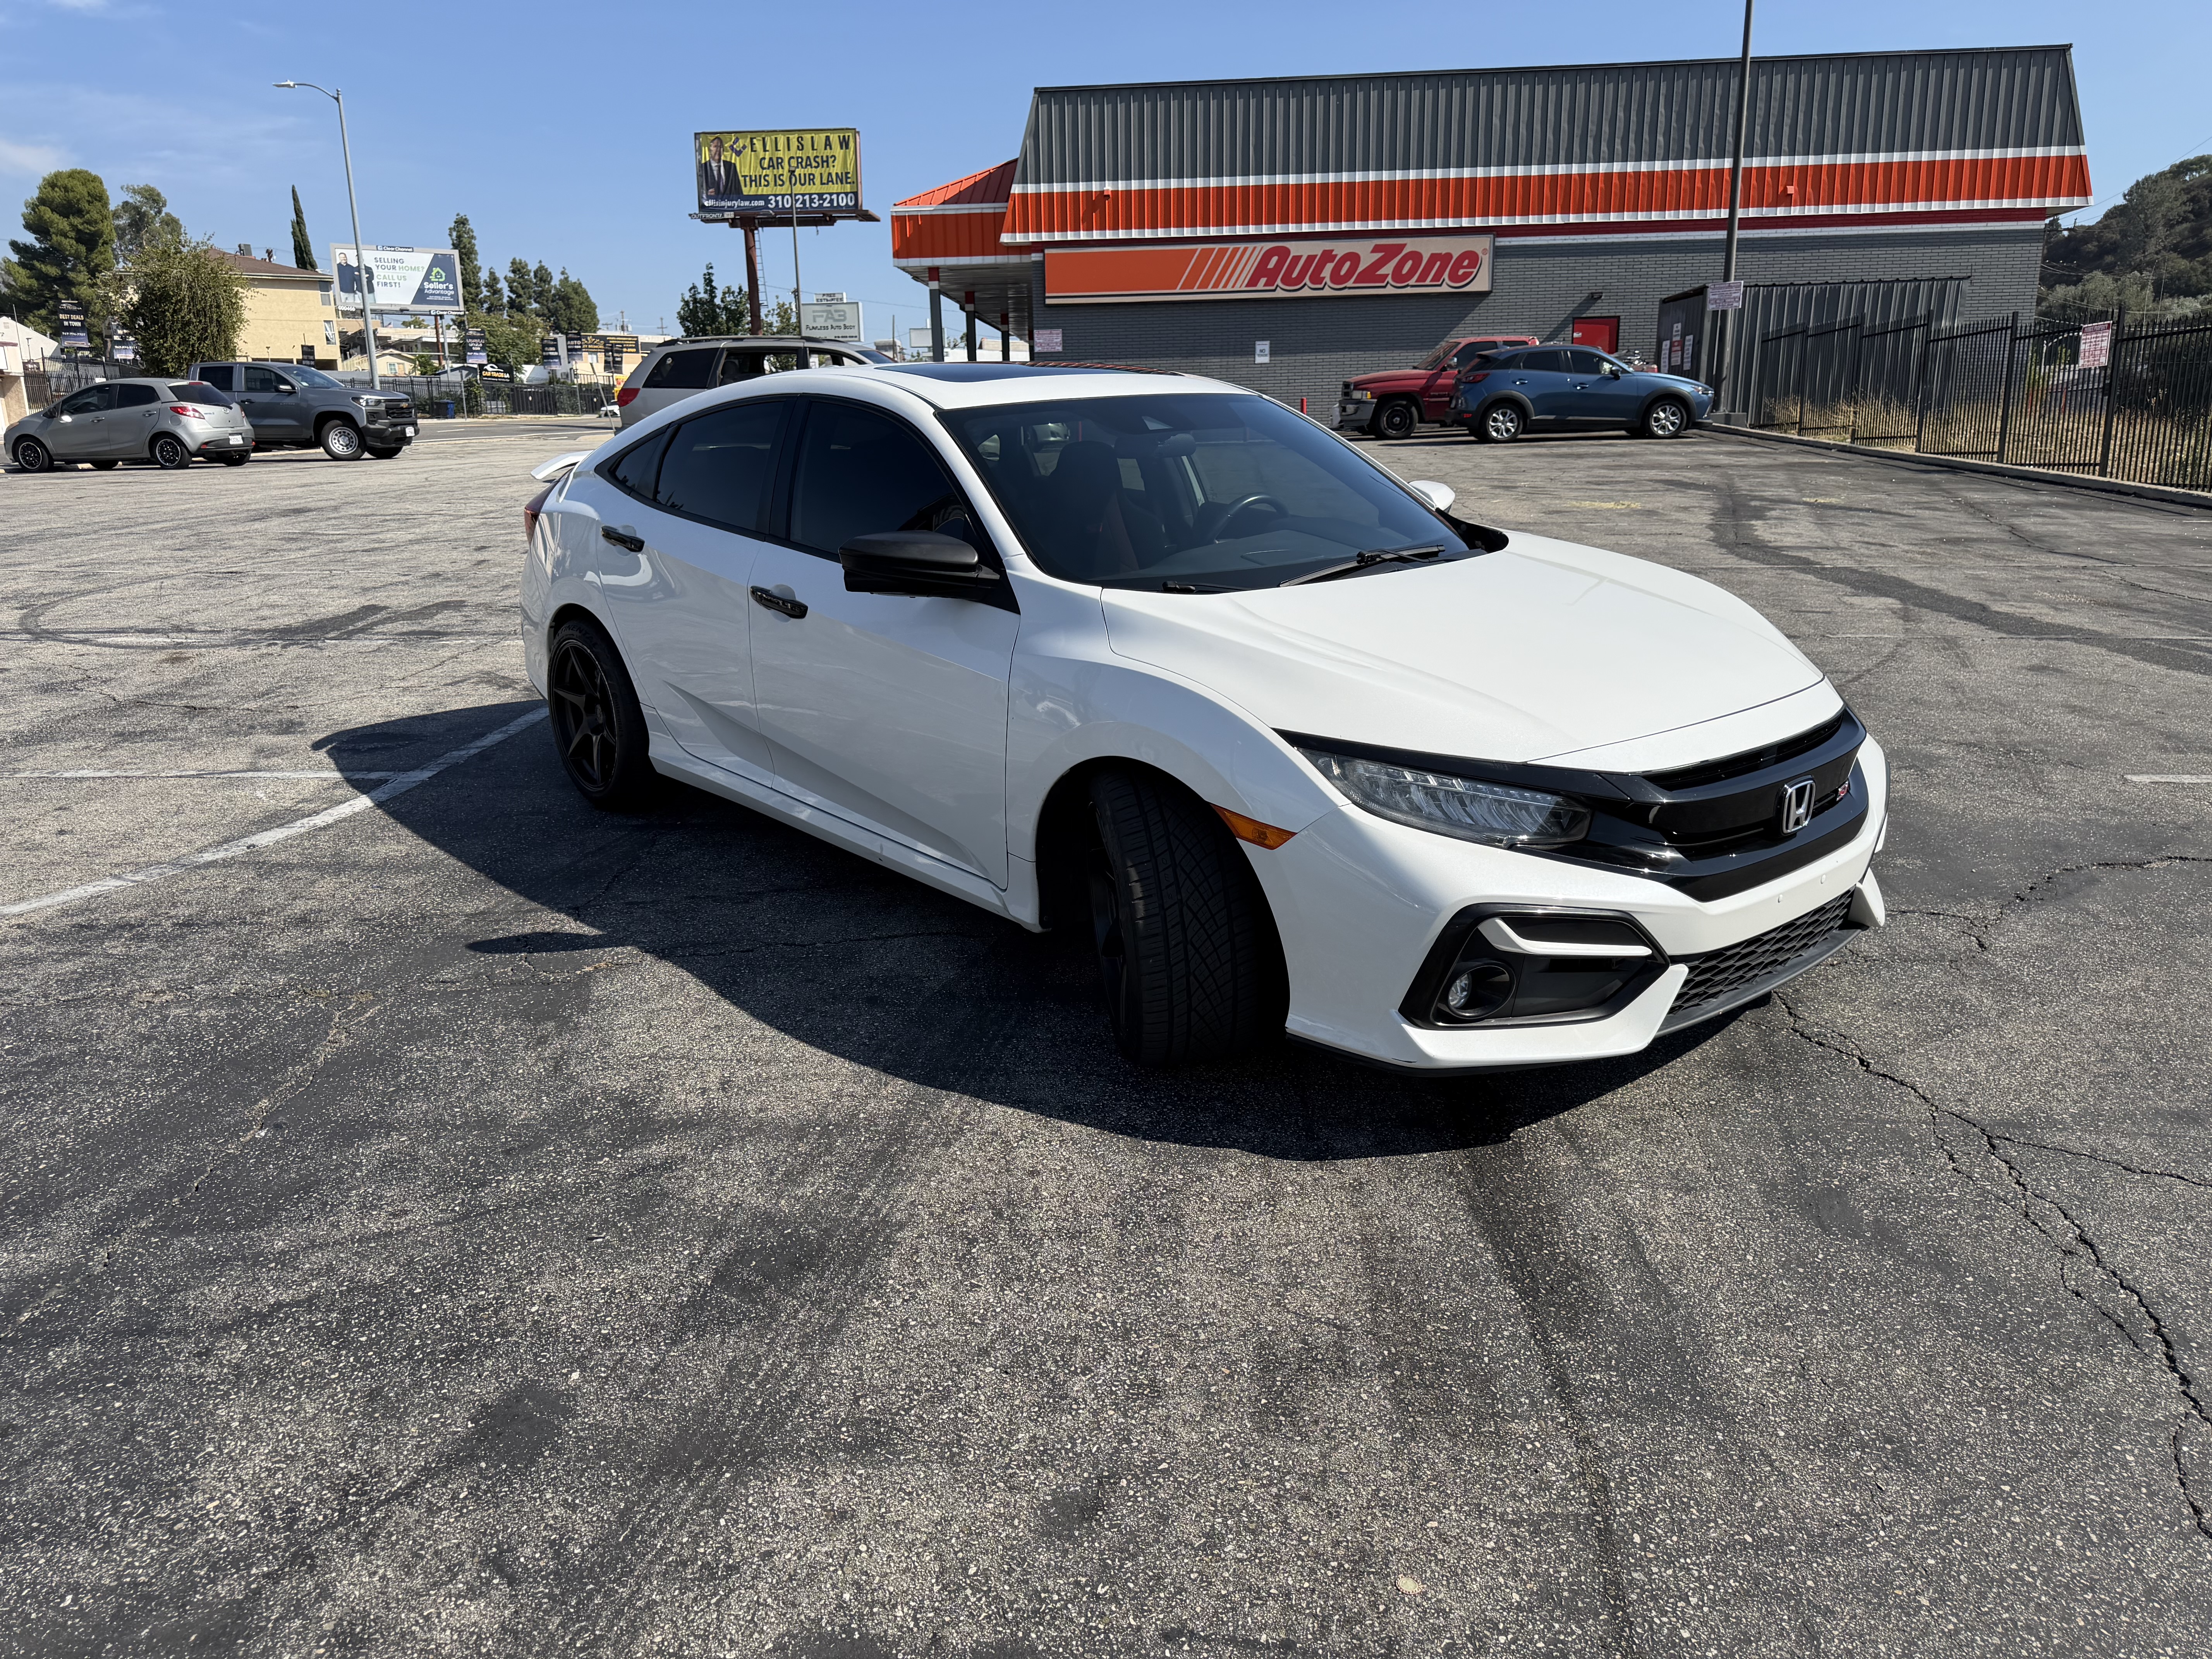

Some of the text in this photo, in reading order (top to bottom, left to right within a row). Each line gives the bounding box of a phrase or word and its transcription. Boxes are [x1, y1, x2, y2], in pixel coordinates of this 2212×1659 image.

[759, 155, 836, 170] CAR CRASH?
[742, 172, 855, 188] THIS IS OUR LANE.
[1244, 243, 1480, 288] AutoZone
[424, 282, 453, 290] Seller's
